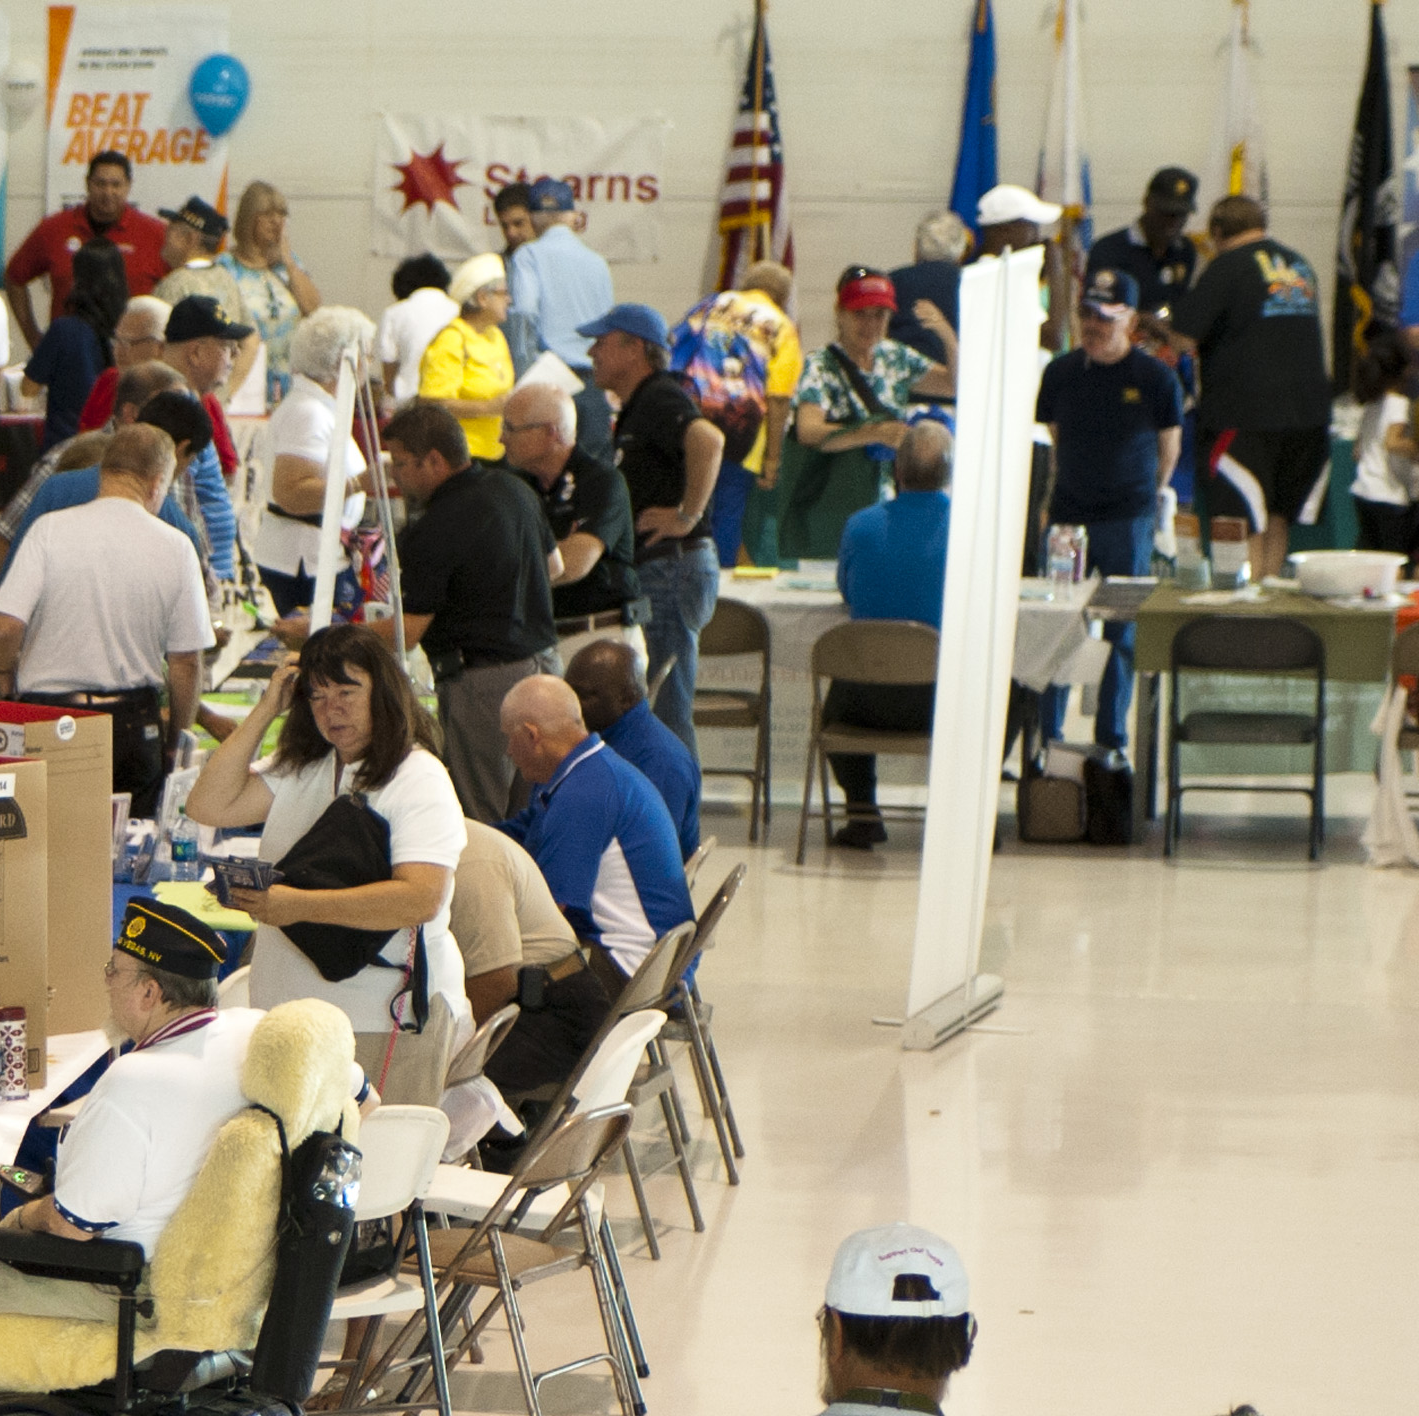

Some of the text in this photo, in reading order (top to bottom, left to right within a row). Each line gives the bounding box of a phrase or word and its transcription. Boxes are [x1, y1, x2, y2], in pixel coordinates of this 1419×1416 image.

[66, 92, 151, 129] BEAT
[61, 127, 210, 165] AVERAGE
[148, 951, 162, 962] NV
[878, 1248, 907, 1261] Support
